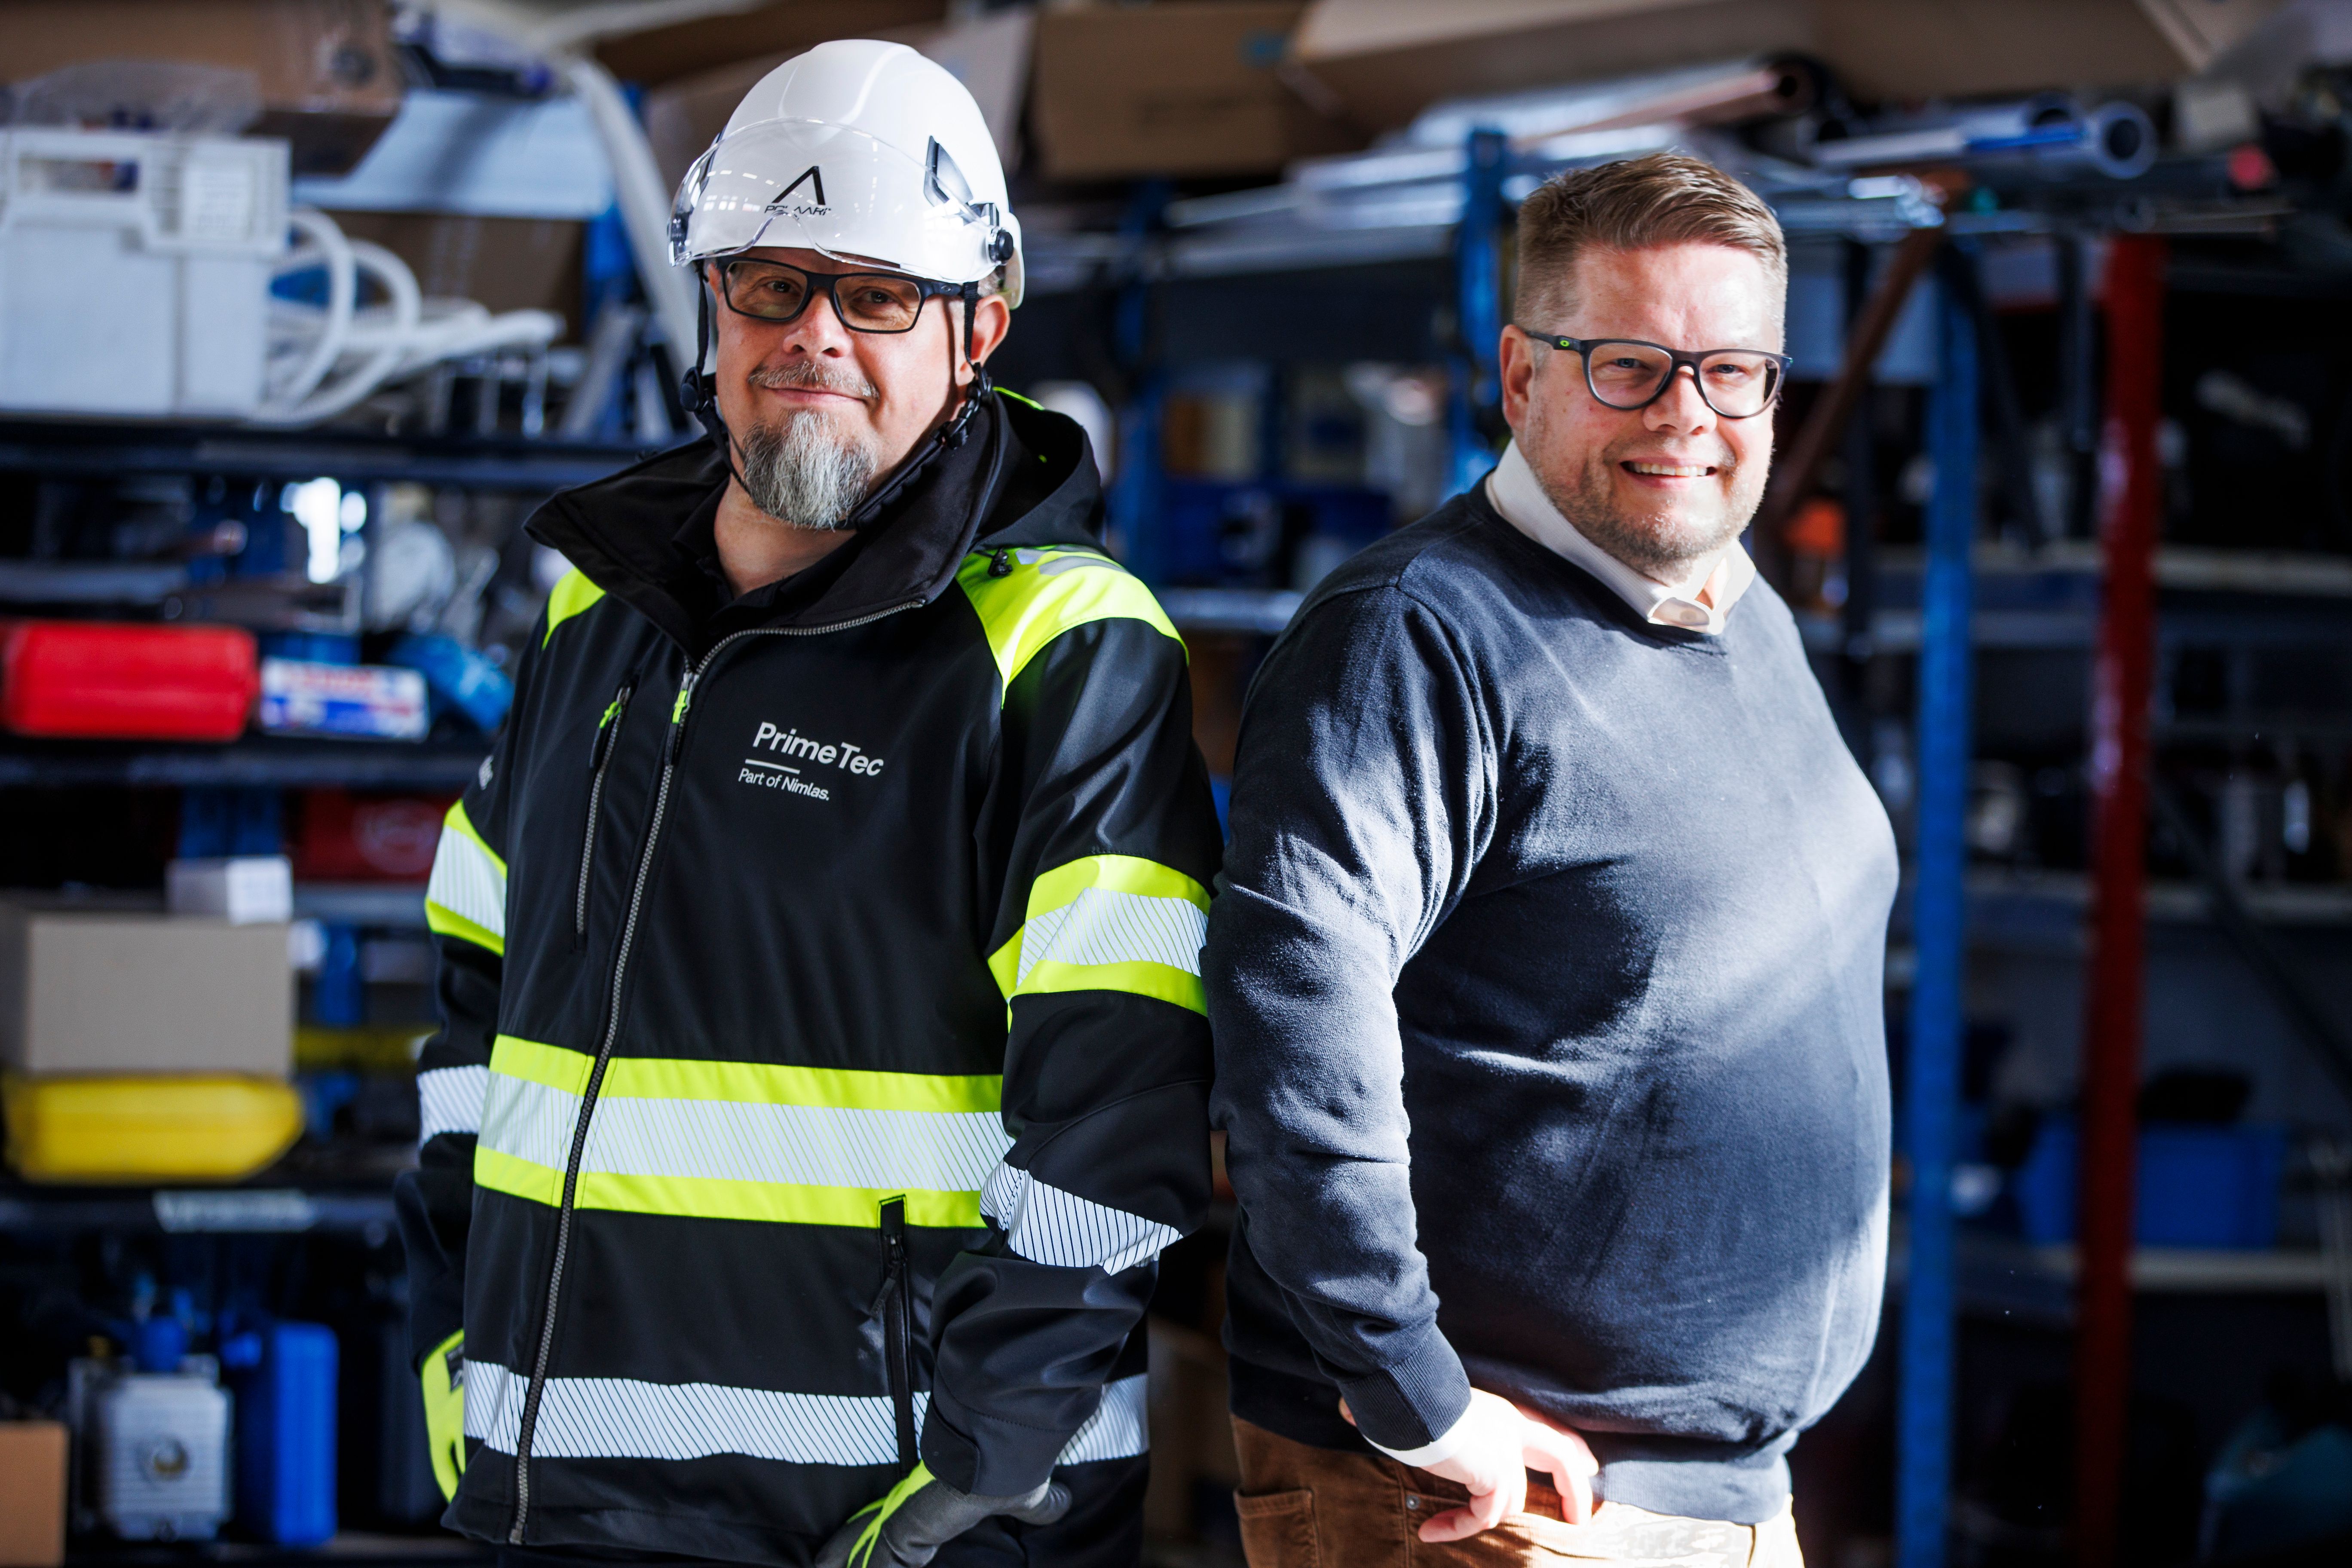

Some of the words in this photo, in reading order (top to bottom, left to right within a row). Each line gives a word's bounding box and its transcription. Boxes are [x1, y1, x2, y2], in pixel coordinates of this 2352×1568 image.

[738, 768, 765, 785] Part
[766, 775, 782, 788] of
[781, 776, 830, 801] Nimlas.
